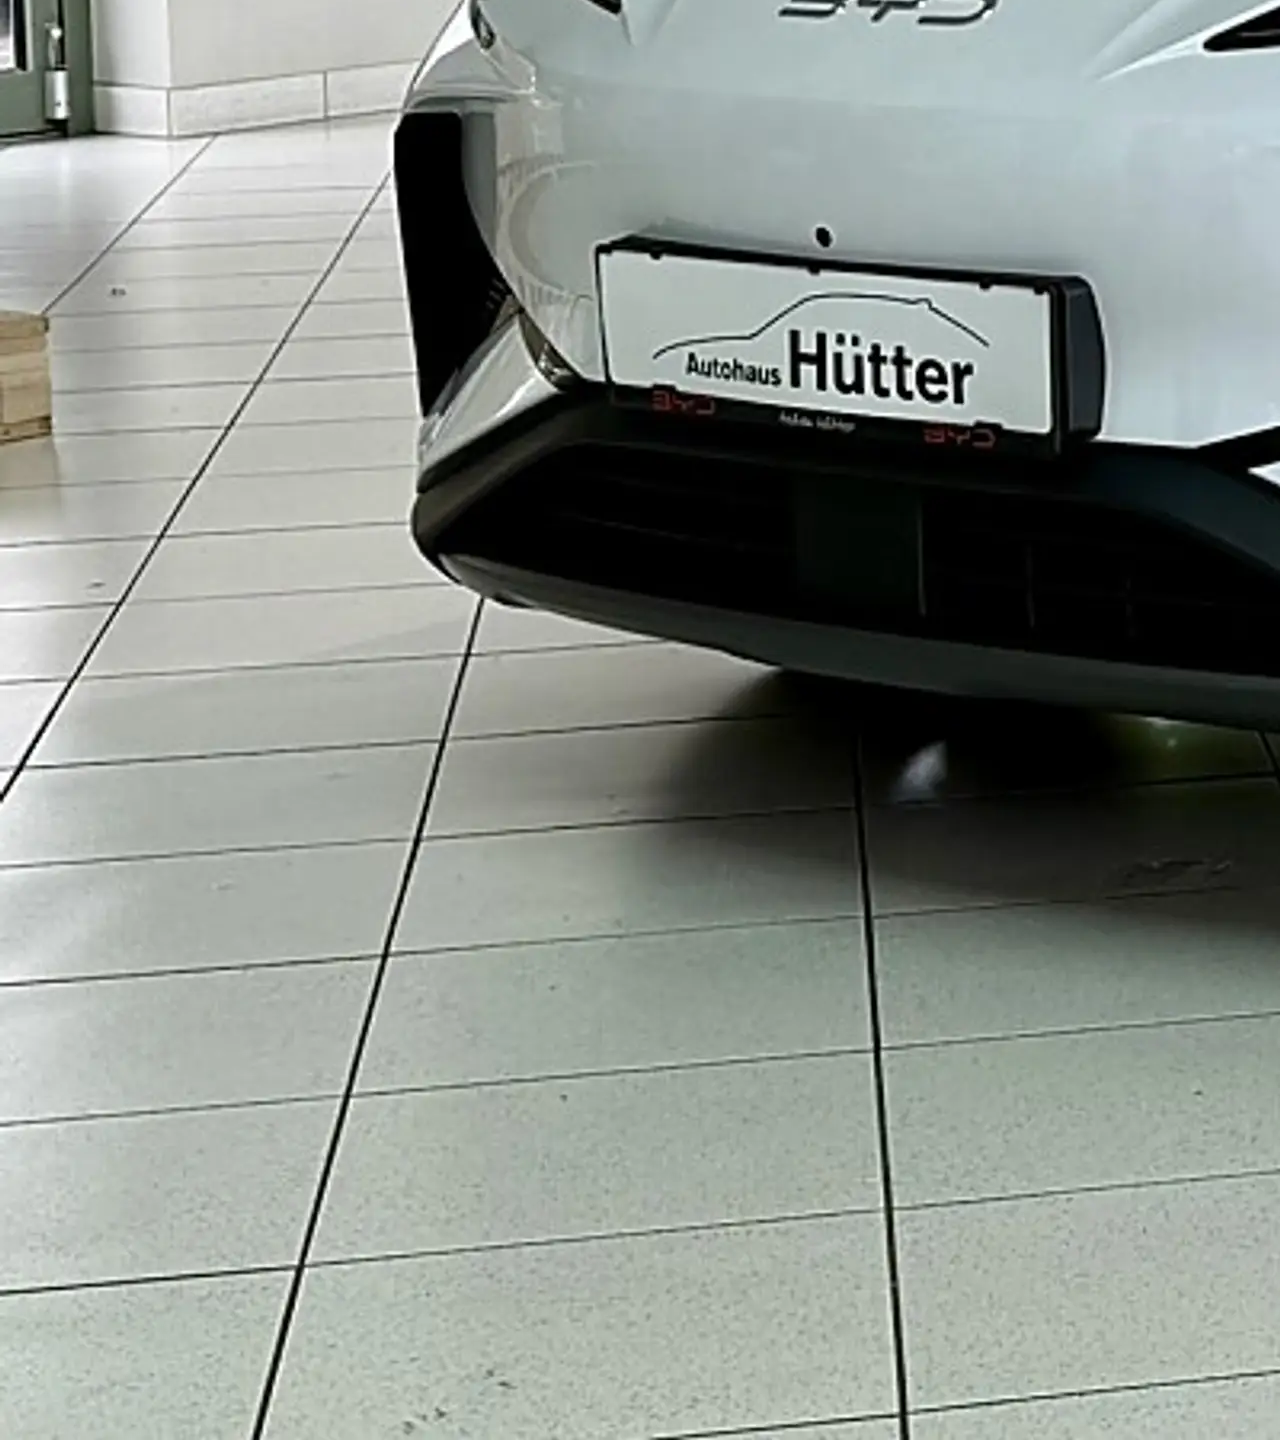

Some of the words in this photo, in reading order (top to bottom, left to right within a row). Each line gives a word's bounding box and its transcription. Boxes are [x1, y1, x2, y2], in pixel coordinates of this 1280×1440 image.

[685, 352, 782, 386] Autohaus
[788, 328, 974, 405] Hütter
[923, 427, 997, 449] BYD
